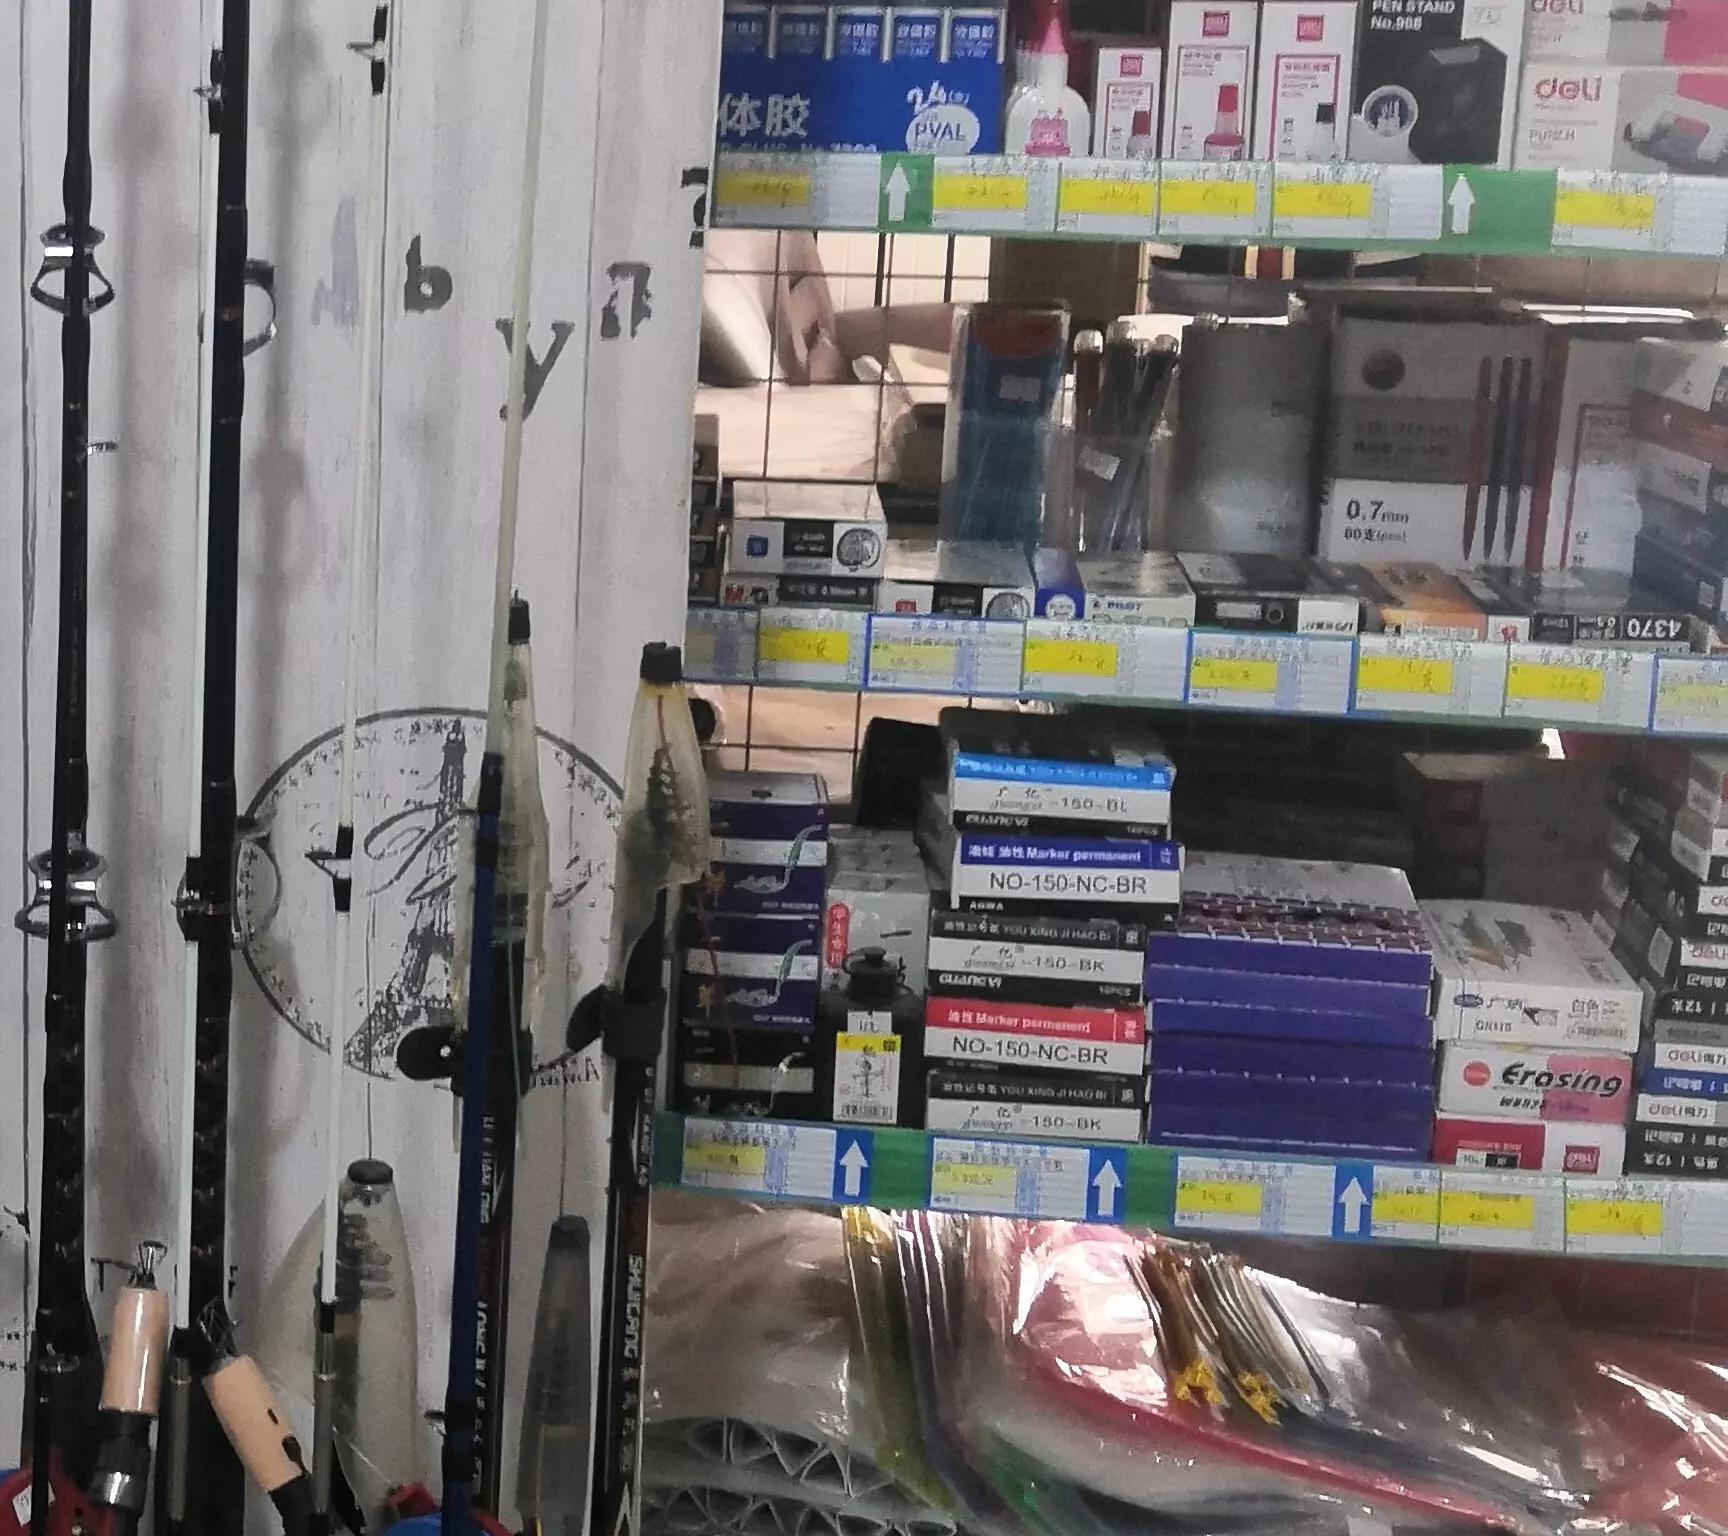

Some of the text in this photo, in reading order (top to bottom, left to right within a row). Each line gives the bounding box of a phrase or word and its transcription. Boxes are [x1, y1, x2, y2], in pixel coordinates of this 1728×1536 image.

[1405, 0, 1456, 16] STAND
[1534, 75, 1602, 102] deli
[1073, 850, 1141, 863] permanent
[989, 873, 1147, 895] NO-150-NC-BR
[952, 1036, 1109, 1065] NO-150-NC-BR
